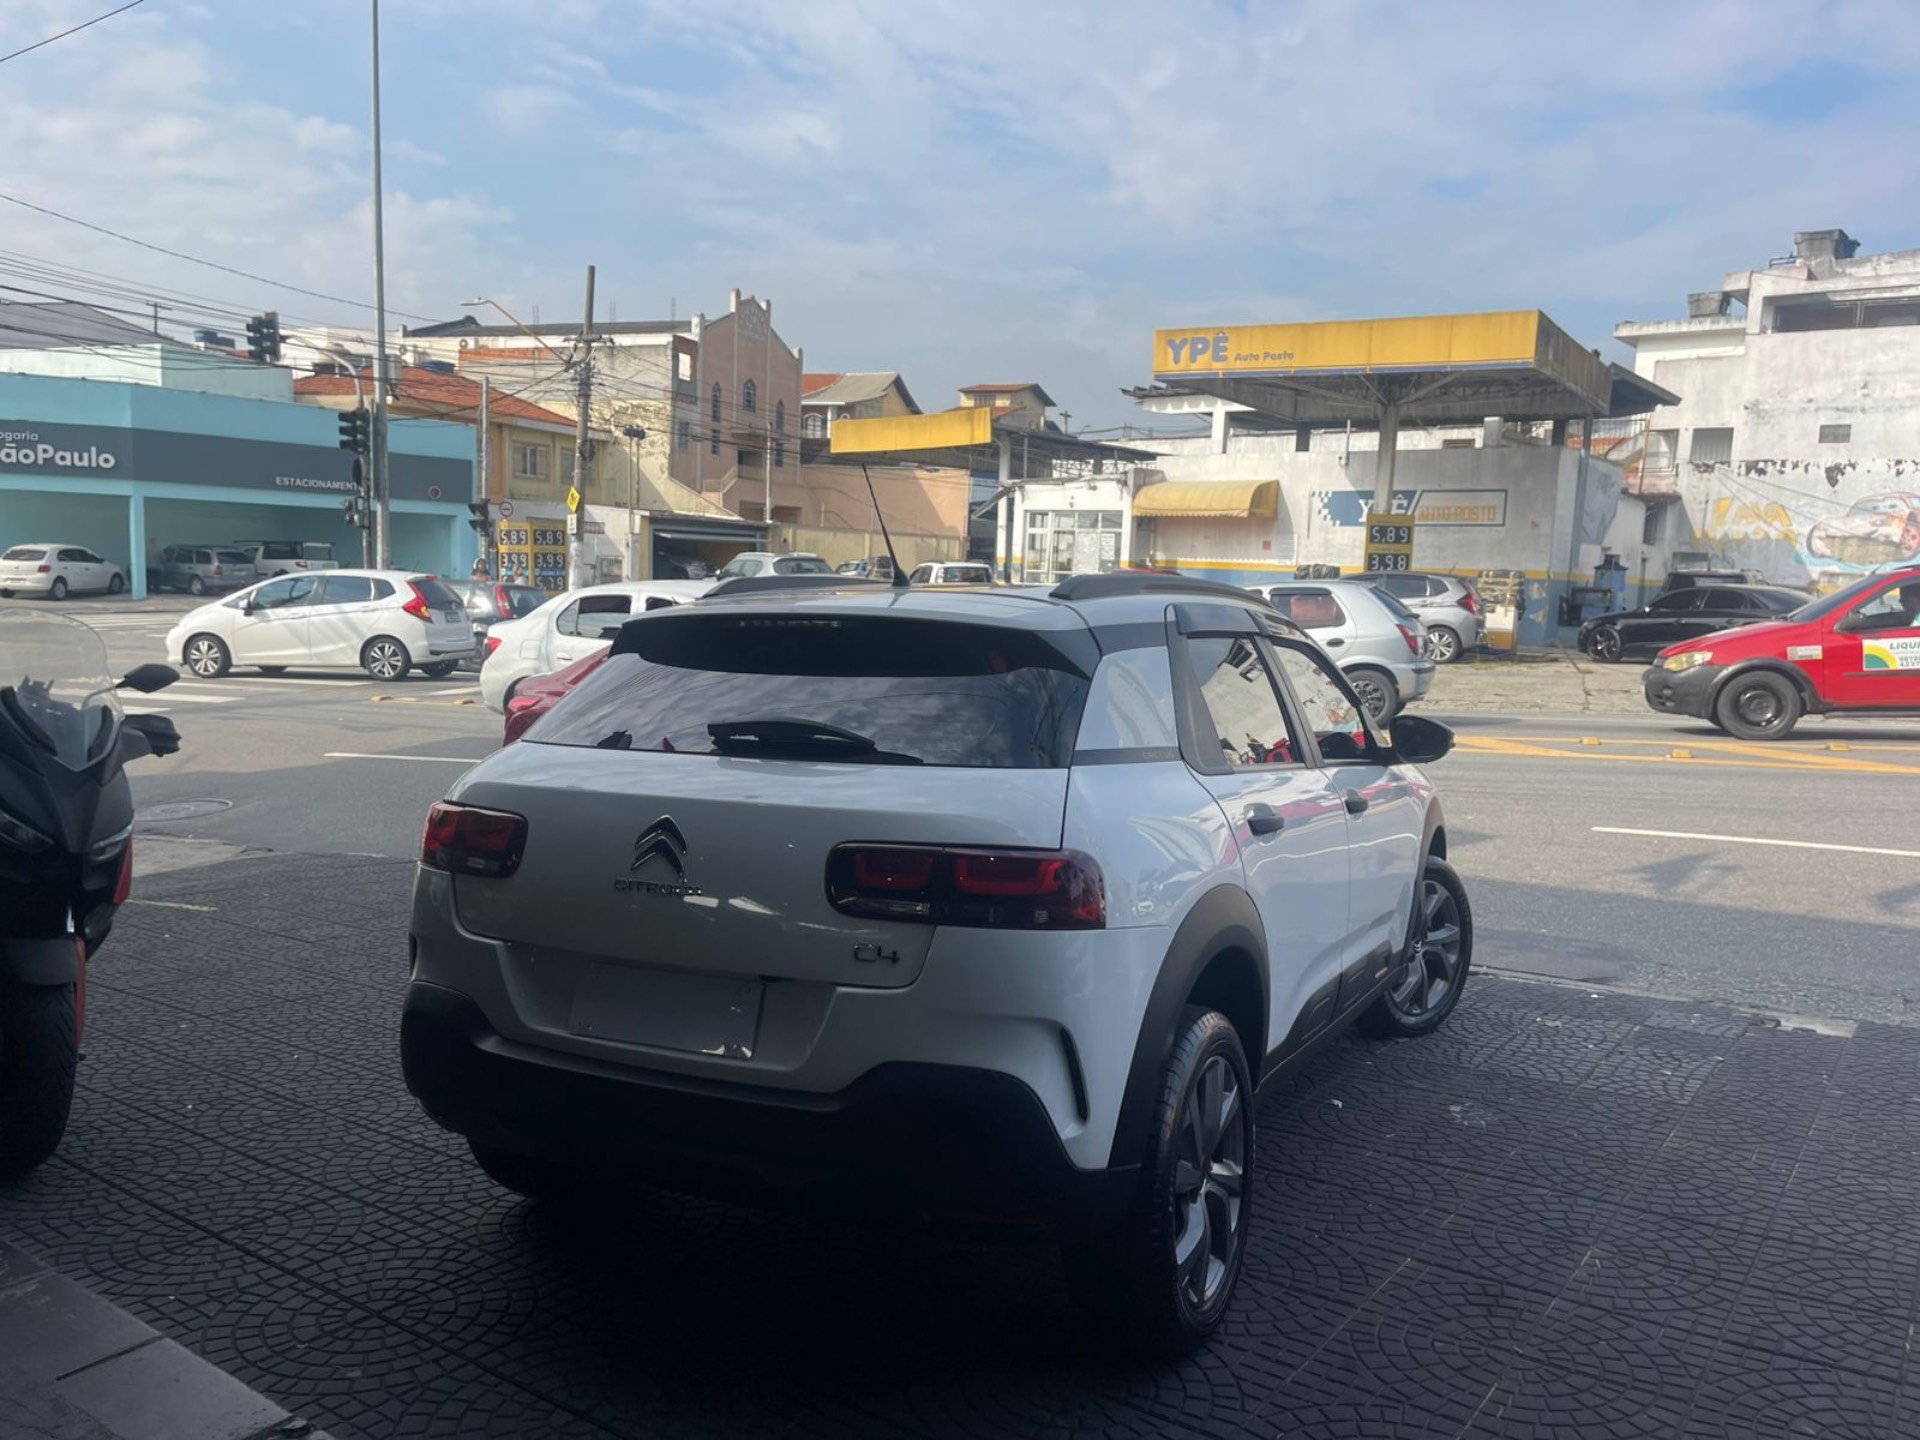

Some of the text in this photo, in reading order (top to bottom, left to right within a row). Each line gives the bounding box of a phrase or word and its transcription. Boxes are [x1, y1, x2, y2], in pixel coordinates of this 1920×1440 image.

[1167, 330, 1295, 365] YPÊ Auto Posto
[275, 476, 360, 492] ESTACIONAMENT
[1358, 493, 1408, 523] YÊ
[501, 530, 527, 544] 5,89
[535, 530, 564, 544] 5,89
[1372, 526, 1409, 543] 5,89
[853, 943, 900, 965] C4
